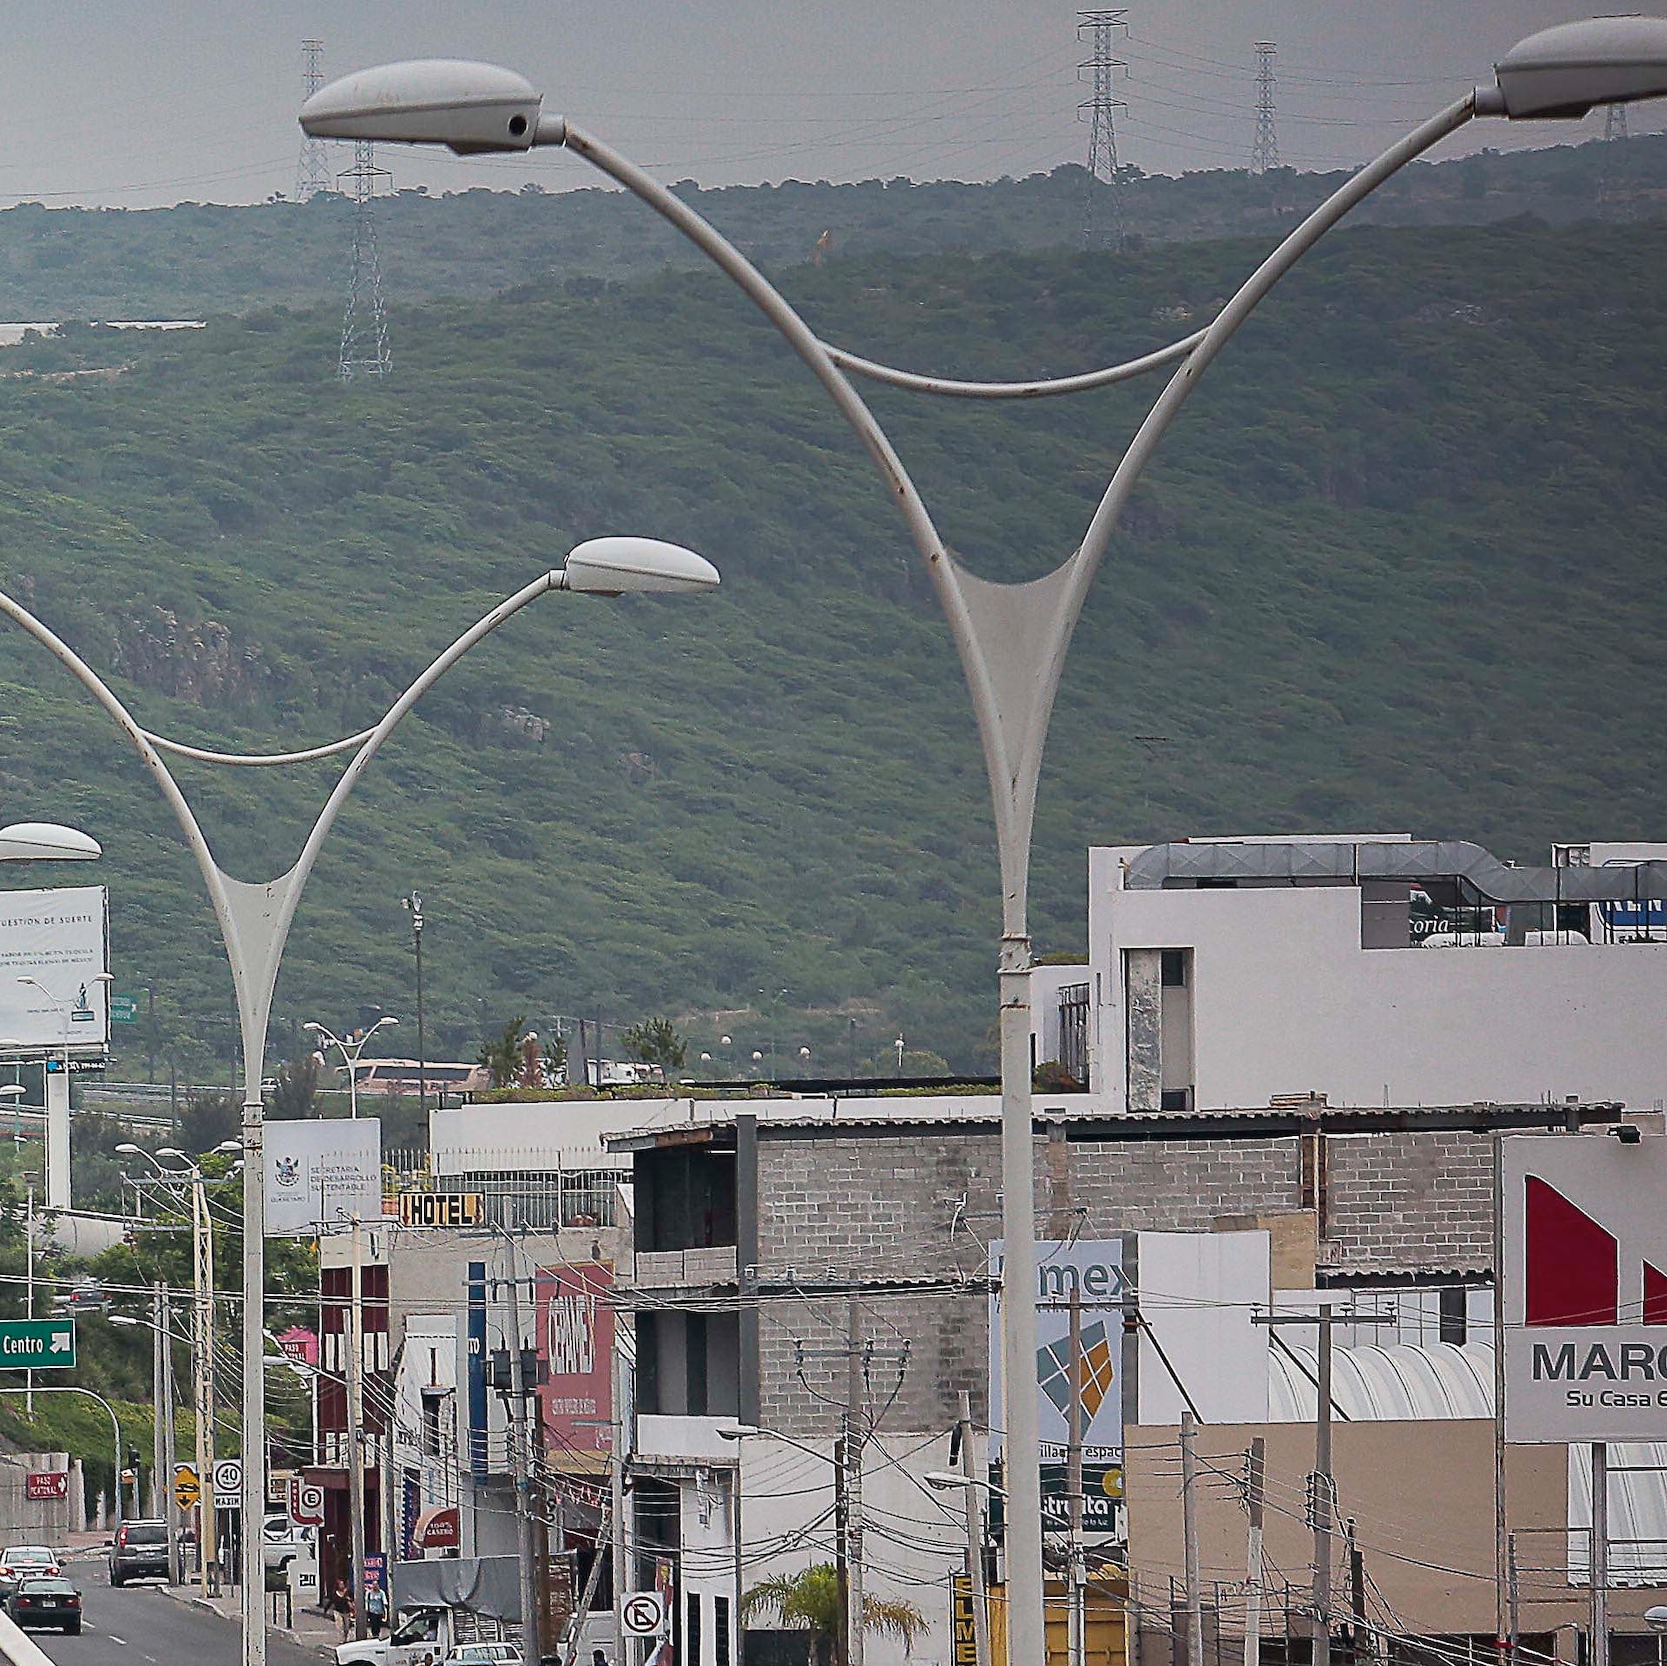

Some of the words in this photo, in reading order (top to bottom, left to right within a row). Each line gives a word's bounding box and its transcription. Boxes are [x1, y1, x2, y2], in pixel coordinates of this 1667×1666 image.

[411, 1195, 473, 1225] HOTEL
[3, 1334, 44, 1354] Centro
[1566, 1389, 1594, 1408] Su
[1600, 1389, 1651, 1408] Casa
[221, 1468, 239, 1481] 40
[215, 1497, 240, 1507] MAXIM
[308, 1493, 316, 1504] E
